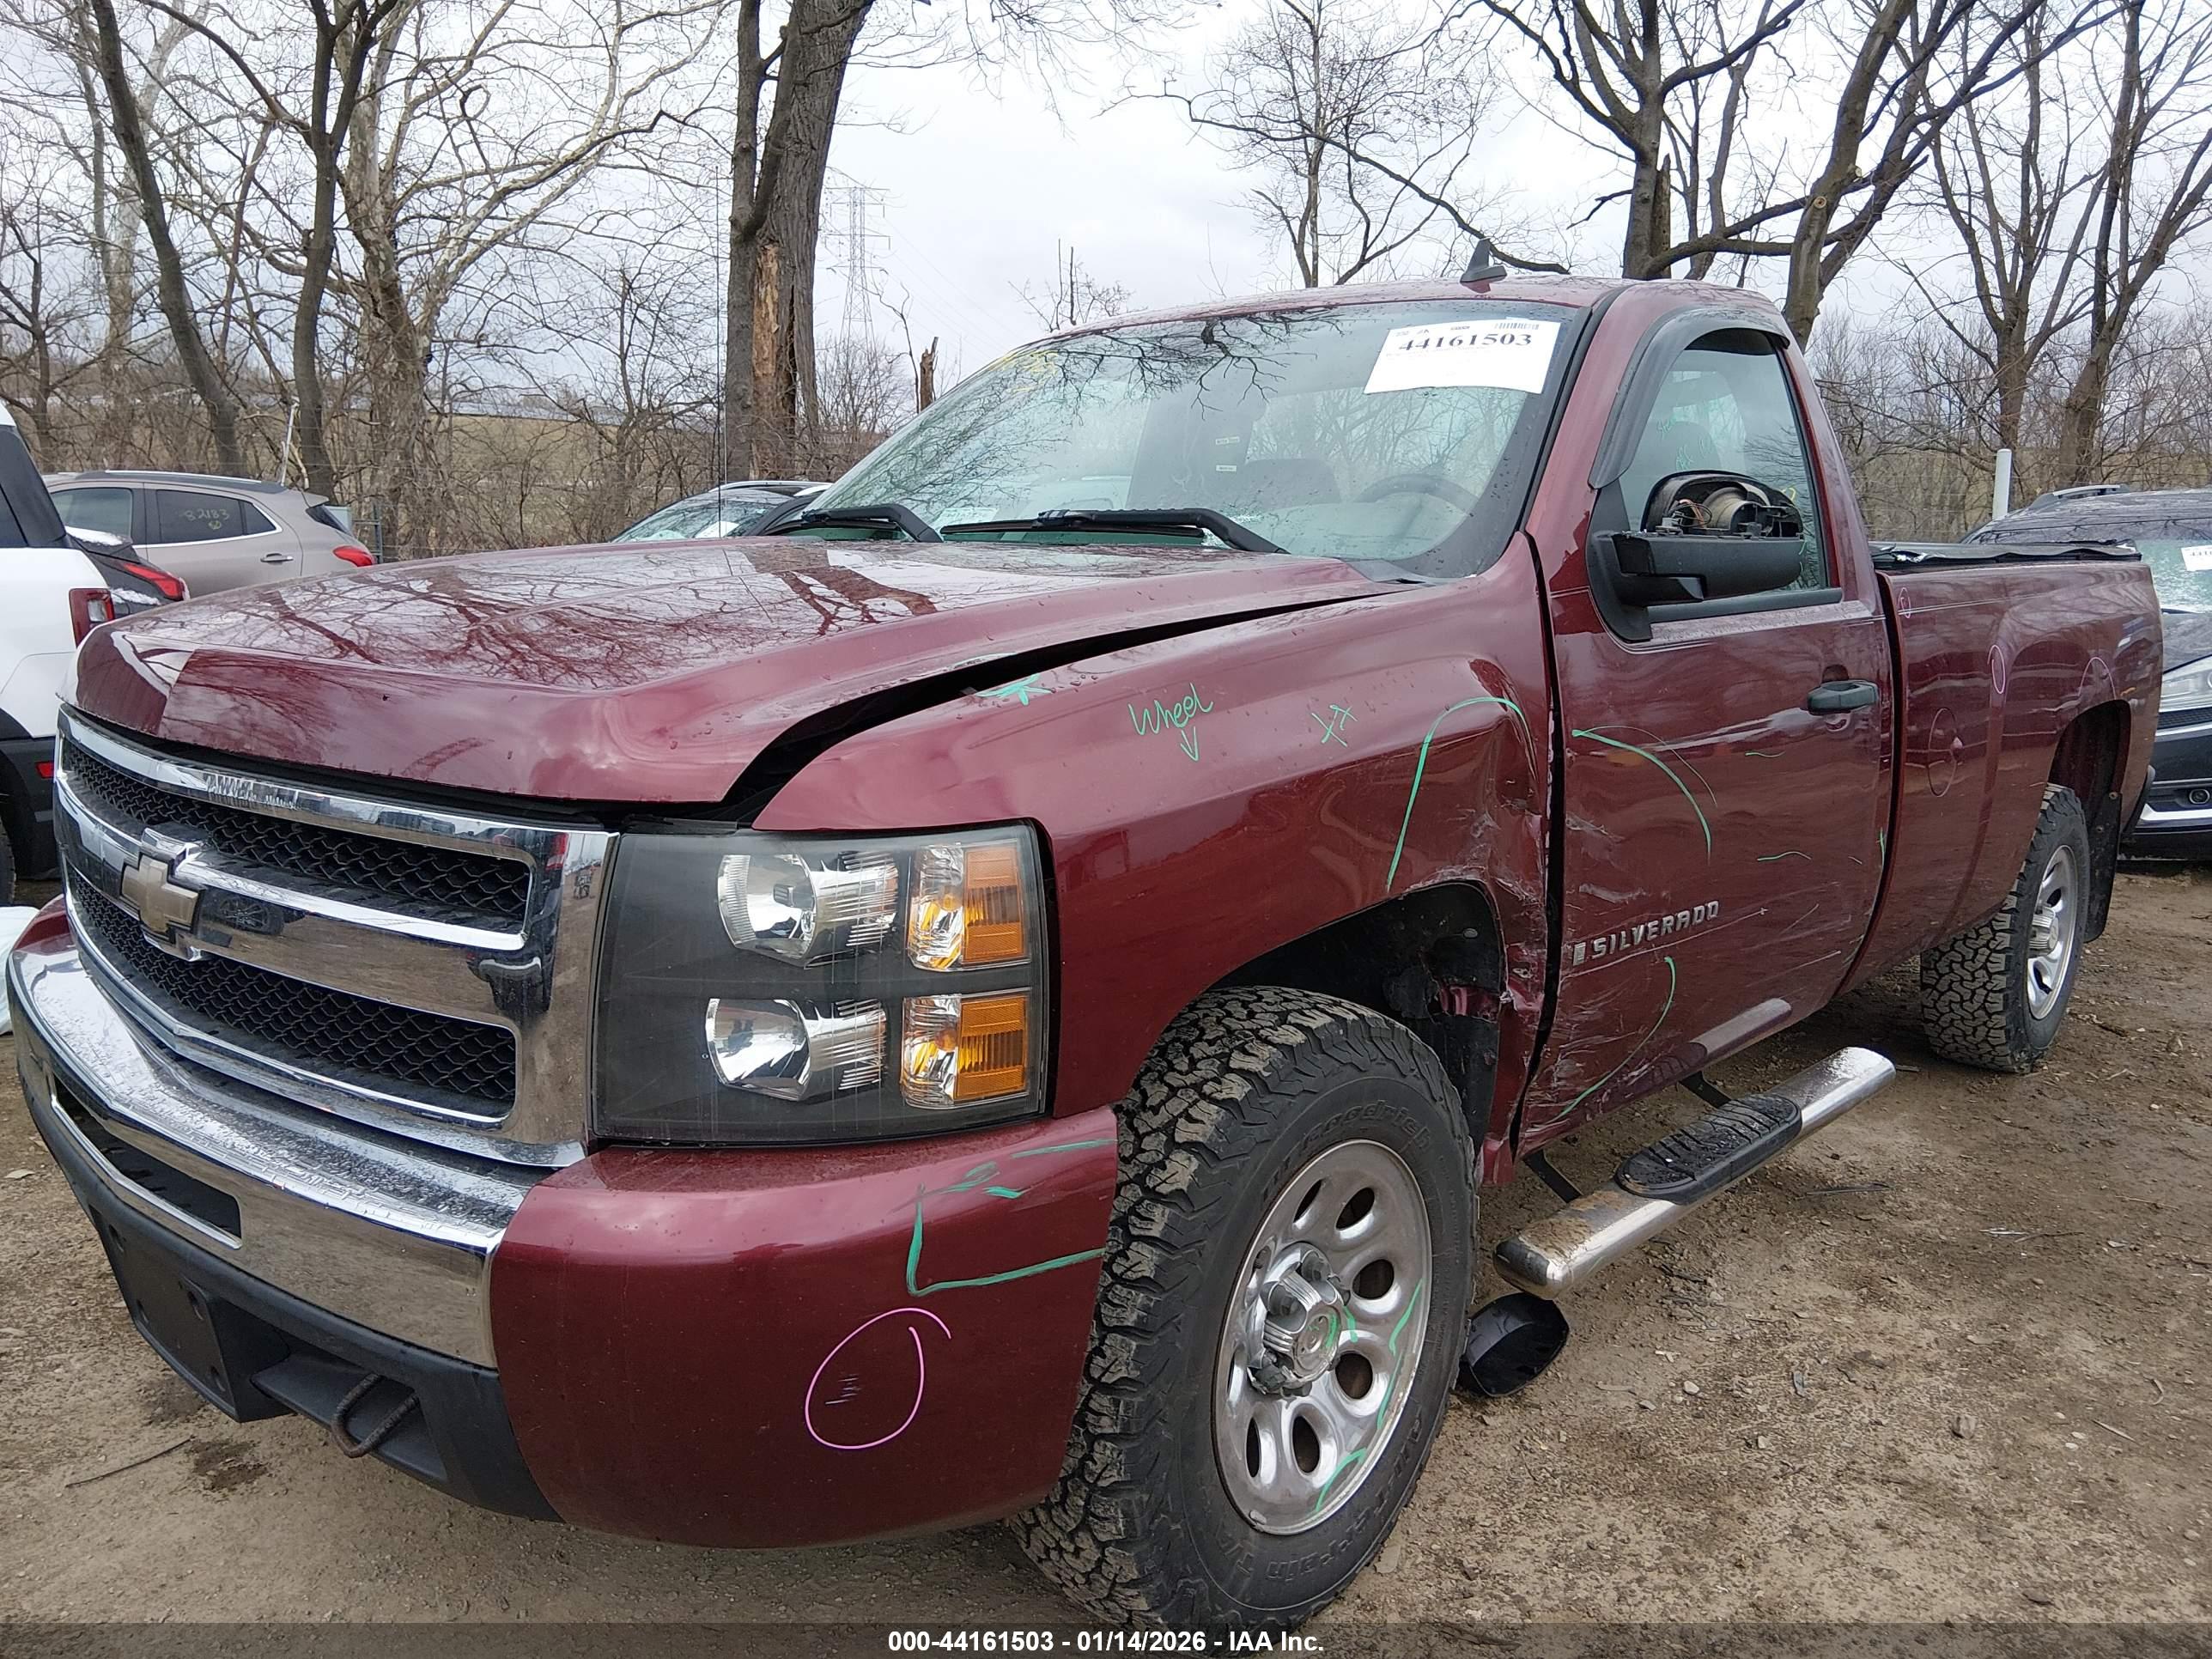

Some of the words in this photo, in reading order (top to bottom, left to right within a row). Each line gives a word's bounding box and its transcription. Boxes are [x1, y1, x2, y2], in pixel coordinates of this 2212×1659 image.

[1398, 333, 1533, 351] 44161503
[1127, 683, 1213, 736] Wheel
[1590, 900, 1720, 960] SILVERADO
